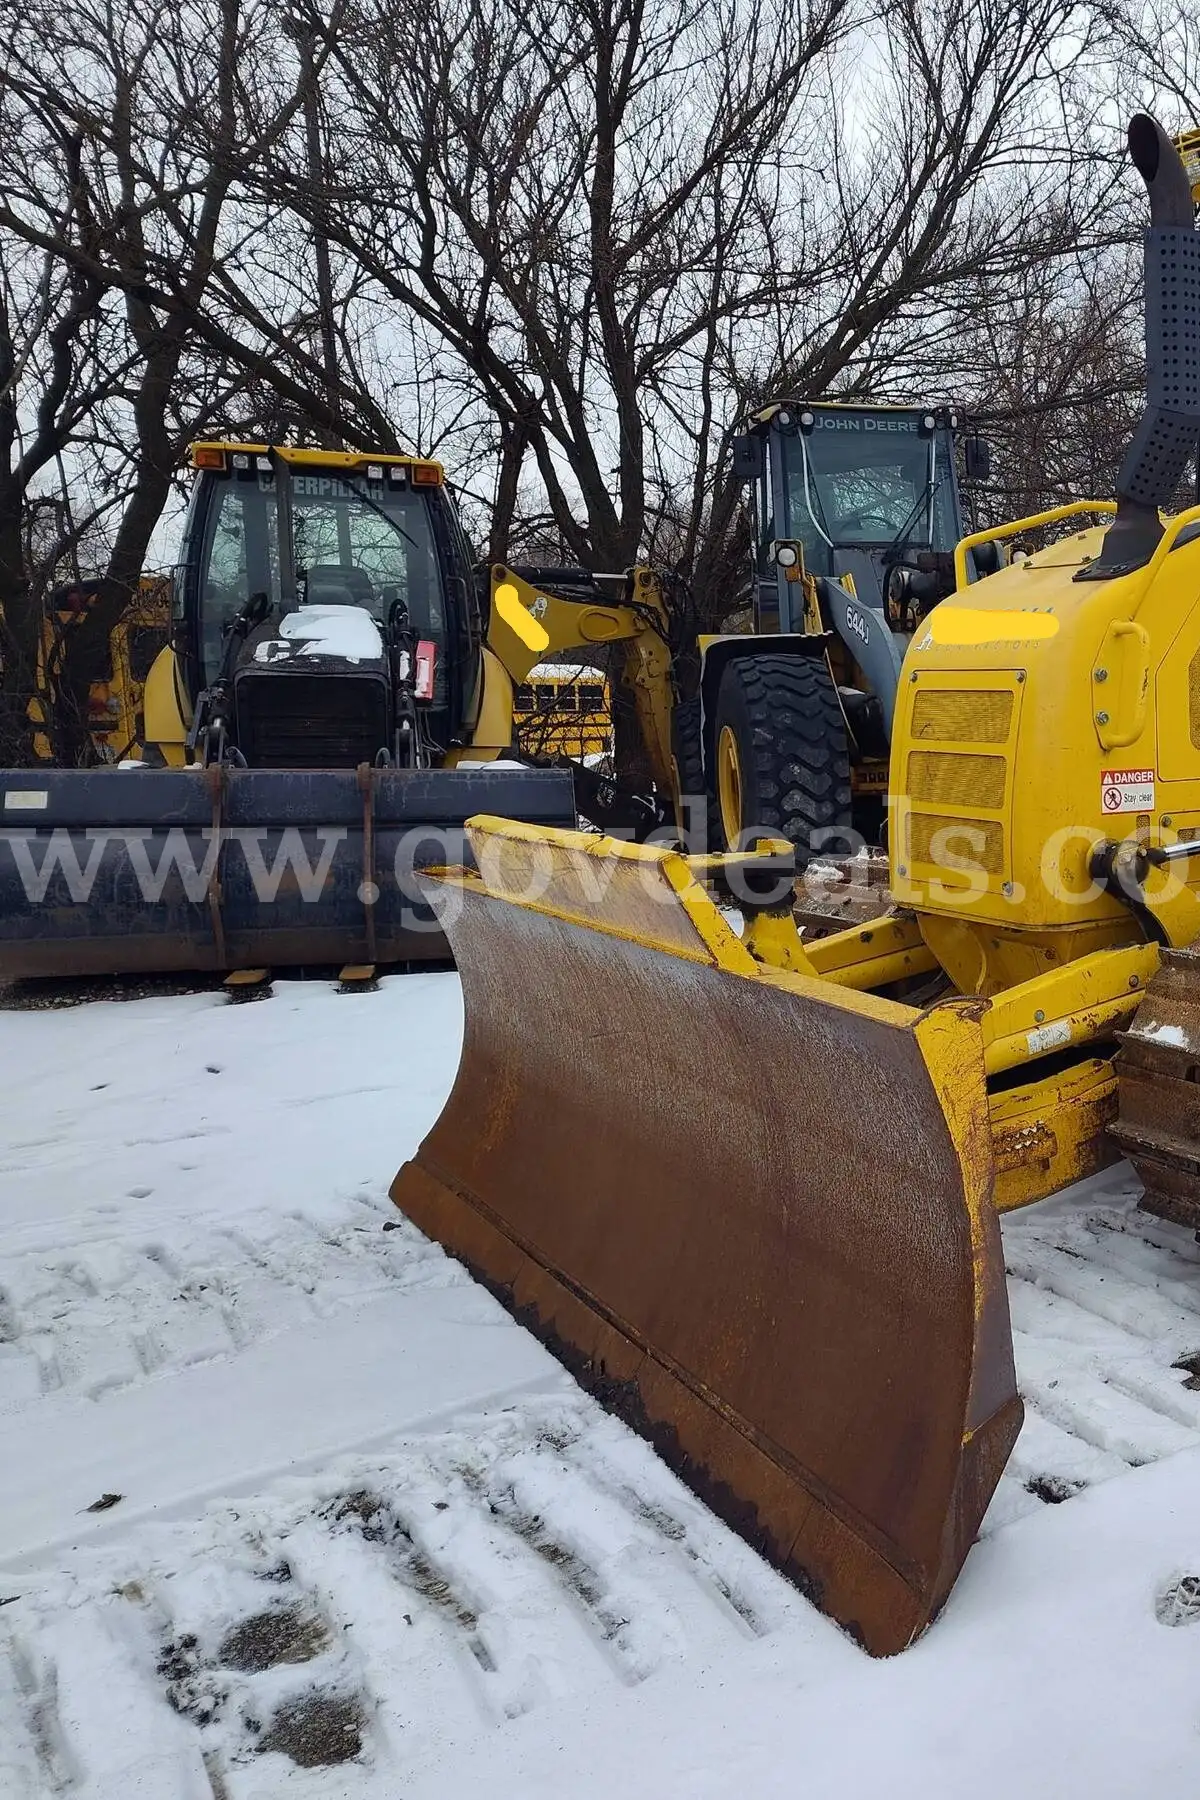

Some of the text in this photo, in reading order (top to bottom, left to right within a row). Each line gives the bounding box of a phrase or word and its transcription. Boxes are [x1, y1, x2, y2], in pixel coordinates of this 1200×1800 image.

[814, 416, 919, 432] JOHN DEERE
[846, 605, 870, 645] 644J
[1113, 771, 1154, 784] DANGER
[1123, 792, 1152, 804] Stay clear
